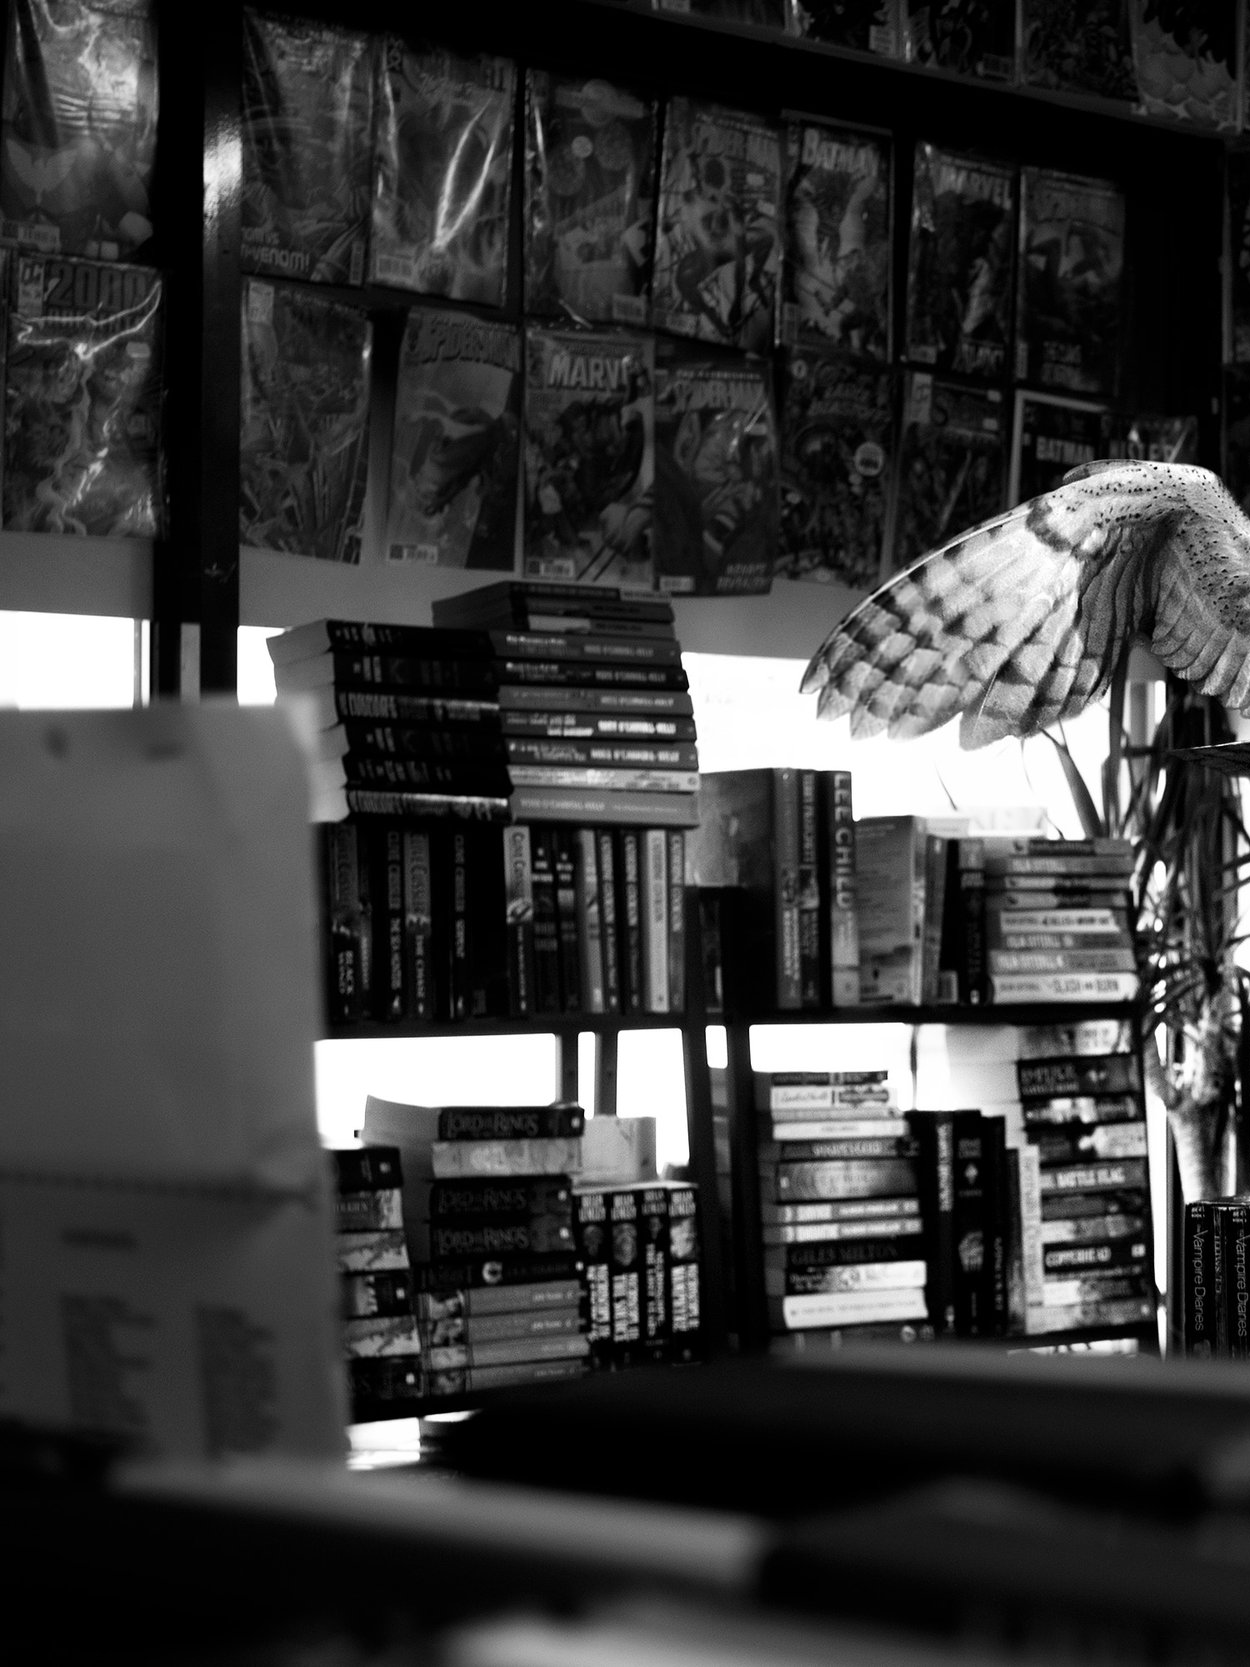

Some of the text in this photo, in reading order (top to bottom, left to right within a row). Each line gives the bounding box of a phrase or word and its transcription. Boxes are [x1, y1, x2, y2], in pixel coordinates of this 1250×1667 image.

[834, 772, 854, 909] LEE CHILD
[1192, 1229, 1209, 1332] Vampire Diaries
[1236, 1291, 1249, 1338] Diaries
